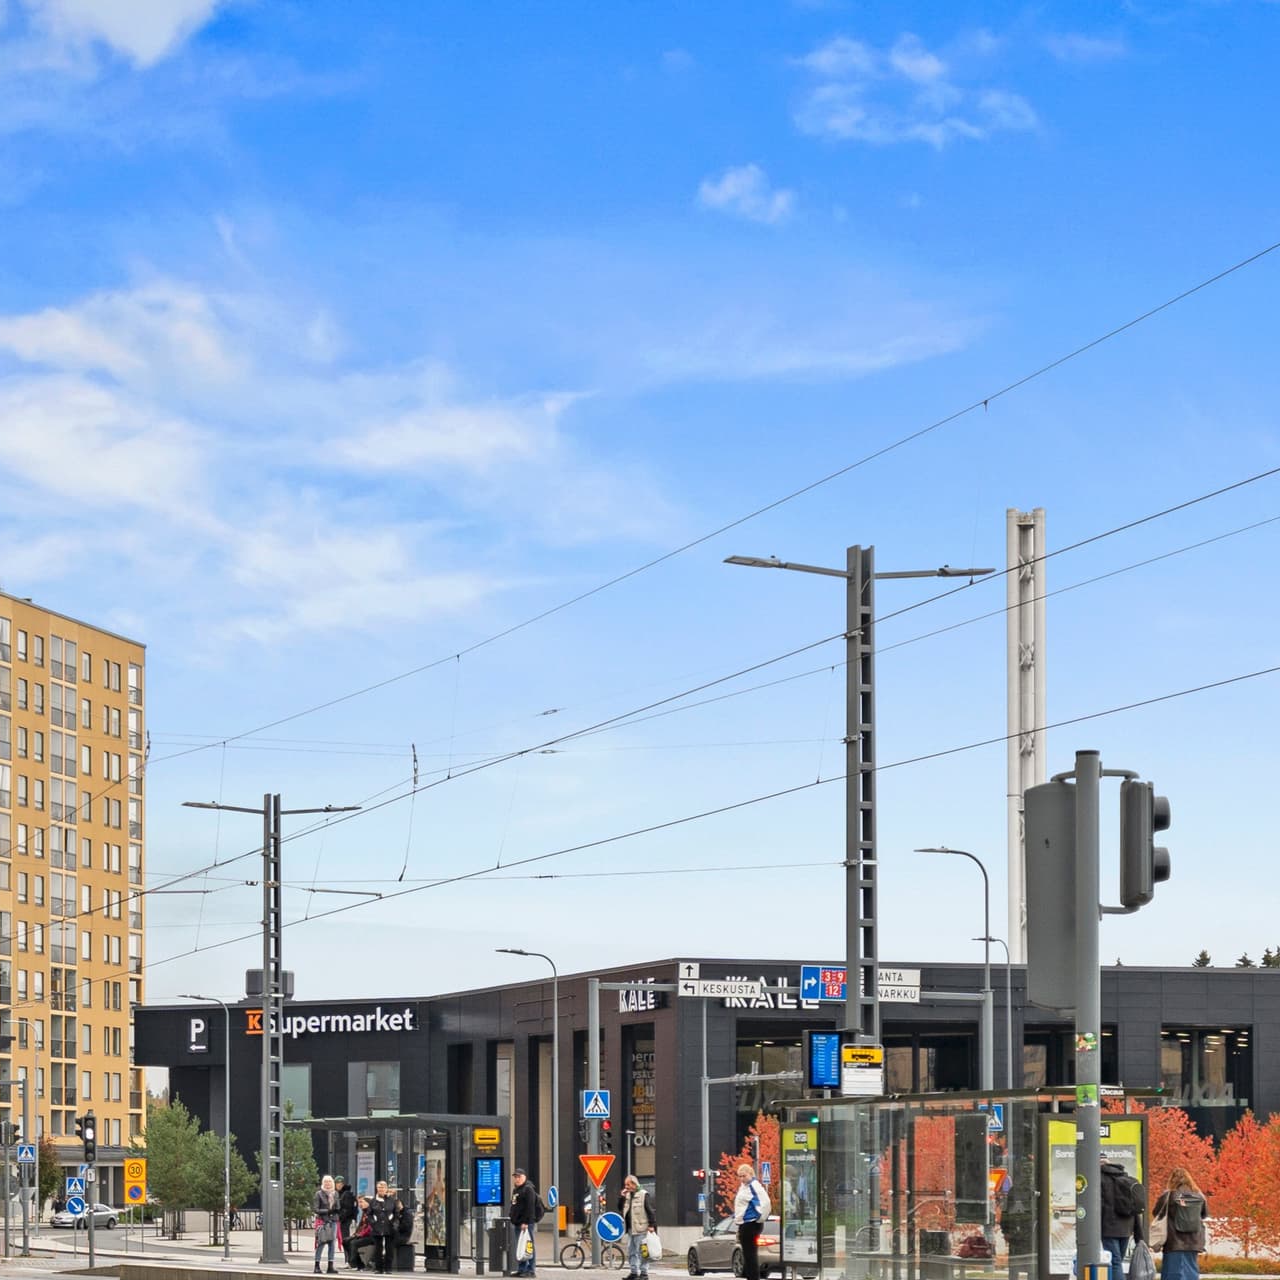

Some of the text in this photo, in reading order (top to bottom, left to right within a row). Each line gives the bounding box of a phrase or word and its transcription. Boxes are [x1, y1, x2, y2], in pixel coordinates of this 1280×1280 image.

[879, 972, 903, 982] ANTA
[702, 983, 756, 995] KESKUSTA
[828, 984, 840, 996] 12
[247, 1012, 262, 1032] K
[190, 1018, 205, 1043] P
[1100, 1087, 1124, 1097] Decaux
[130, 1166, 141, 1175] 30
